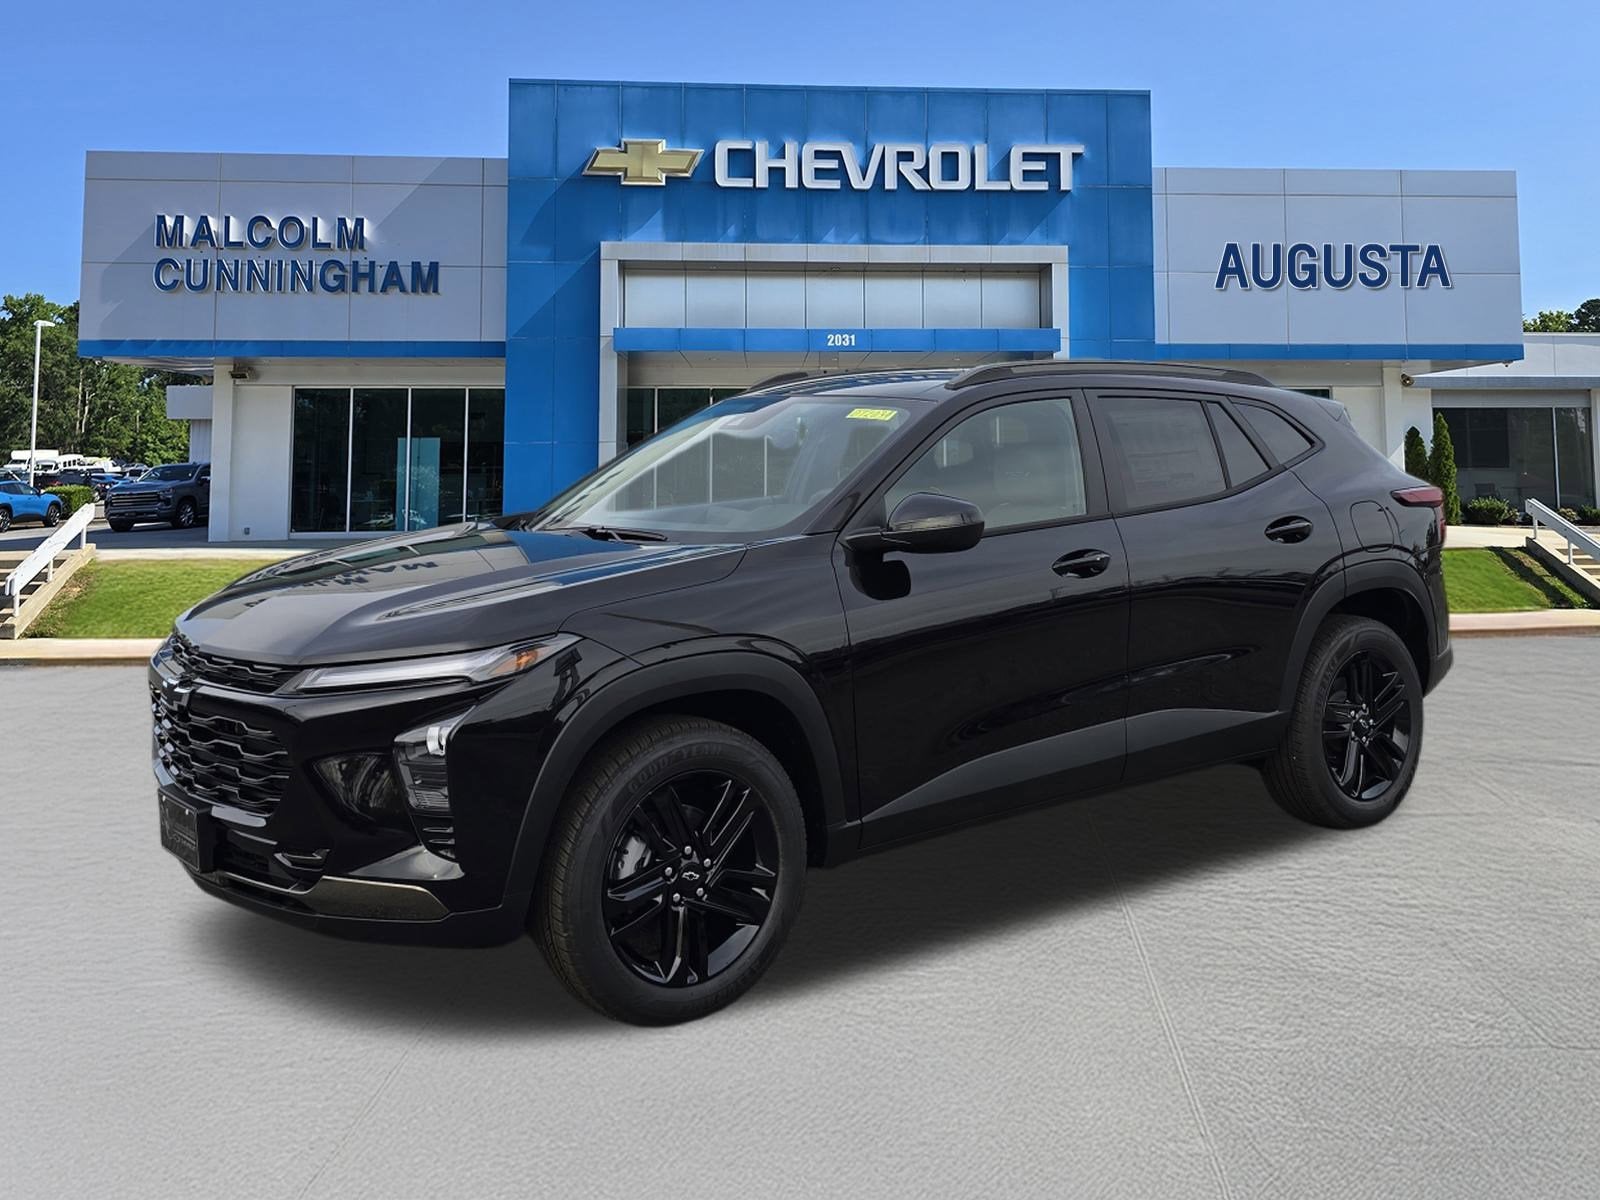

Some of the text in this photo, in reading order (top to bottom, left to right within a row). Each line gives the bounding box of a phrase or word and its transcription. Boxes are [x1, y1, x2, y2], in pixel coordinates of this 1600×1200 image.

[714, 139, 1085, 192] CHEVROLET
[154, 214, 366, 250] MALCOLM
[152, 257, 440, 294] CUNNINGHAM
[1214, 242, 1452, 290] AUGUSTA
[827, 333, 856, 347] 2031
